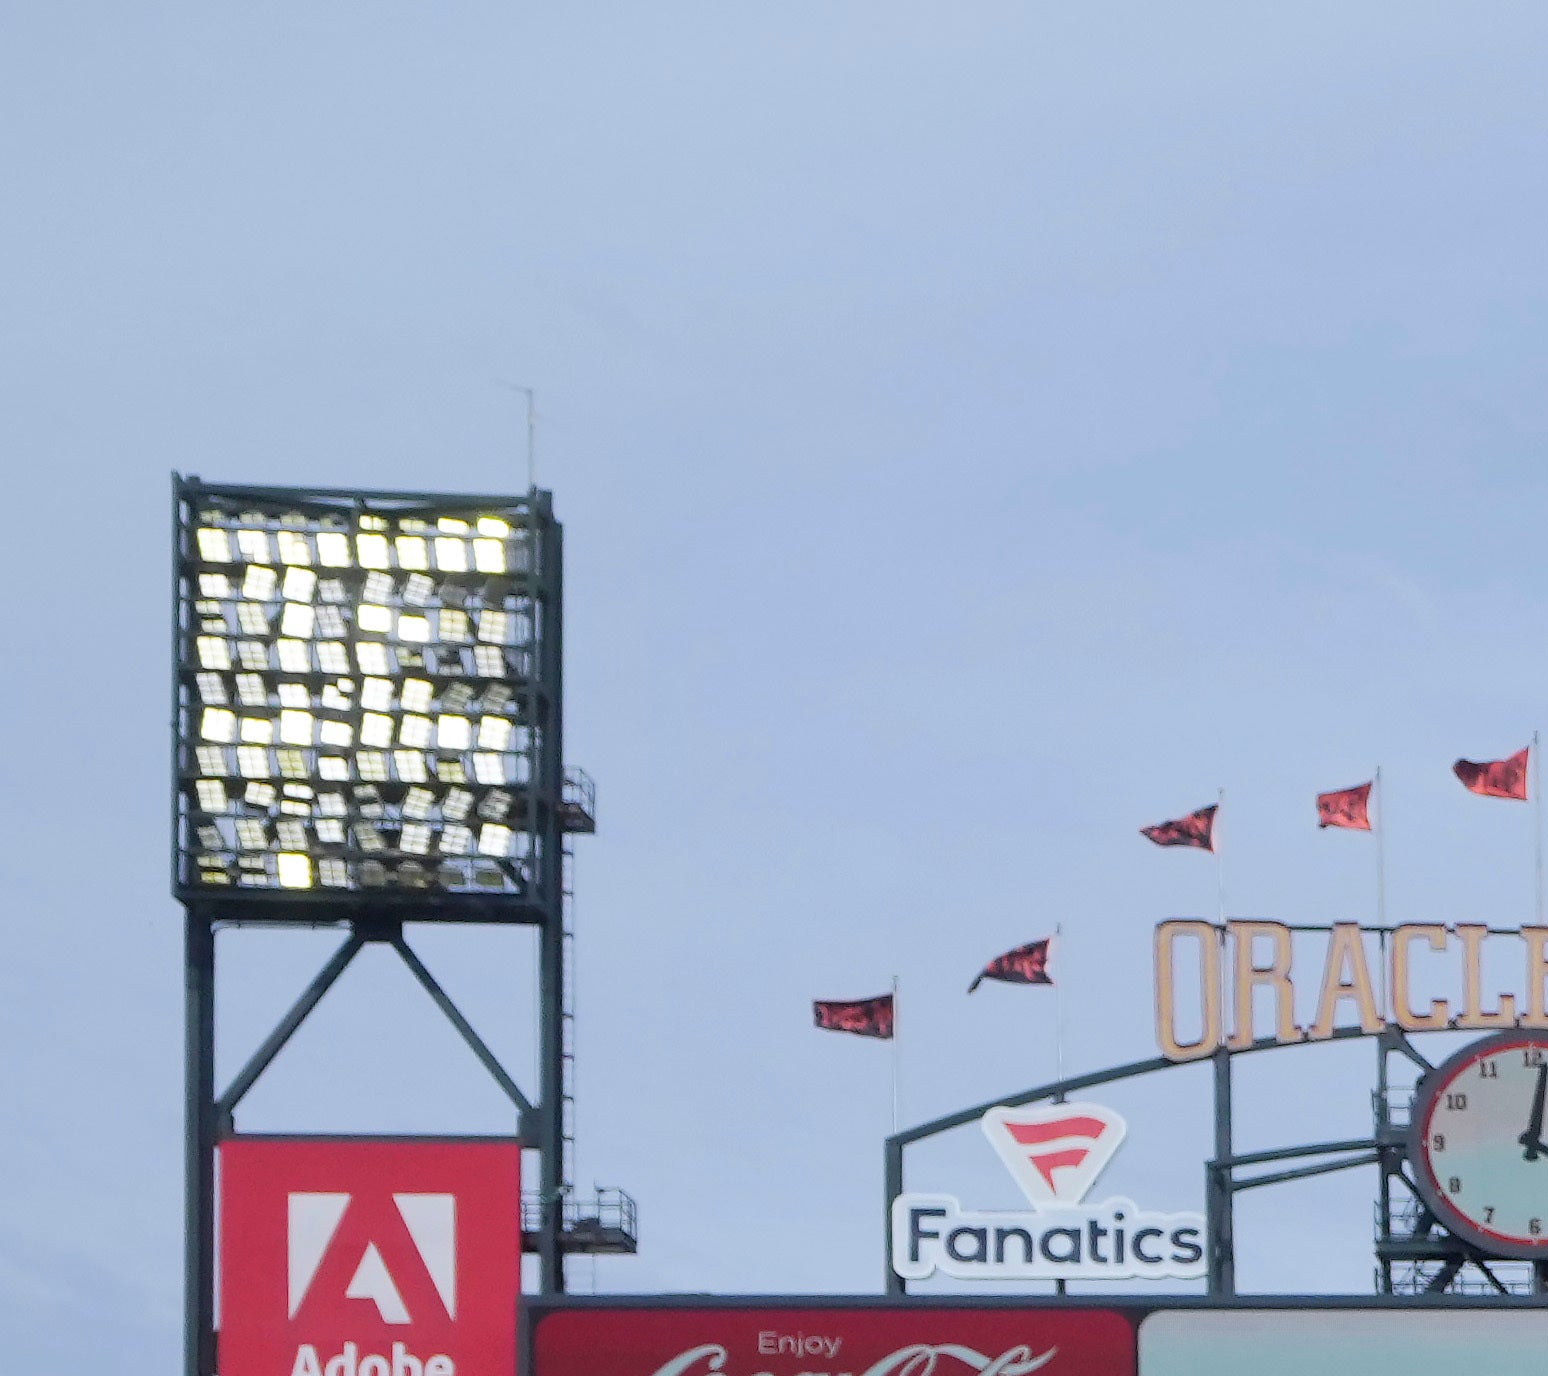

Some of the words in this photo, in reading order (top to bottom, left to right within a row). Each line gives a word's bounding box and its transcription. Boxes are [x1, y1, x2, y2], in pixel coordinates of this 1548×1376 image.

[1479, 1061, 1497, 1080] 11
[1446, 1094, 1468, 1110] 10
[1433, 1135, 1445, 1151] 9
[1449, 1178, 1461, 1194] 8
[1484, 1206, 1495, 1224] 7
[1528, 1217, 1541, 1235] 6
[910, 1208, 1203, 1264] Fanatics
[758, 1330, 842, 1357] Enjoy
